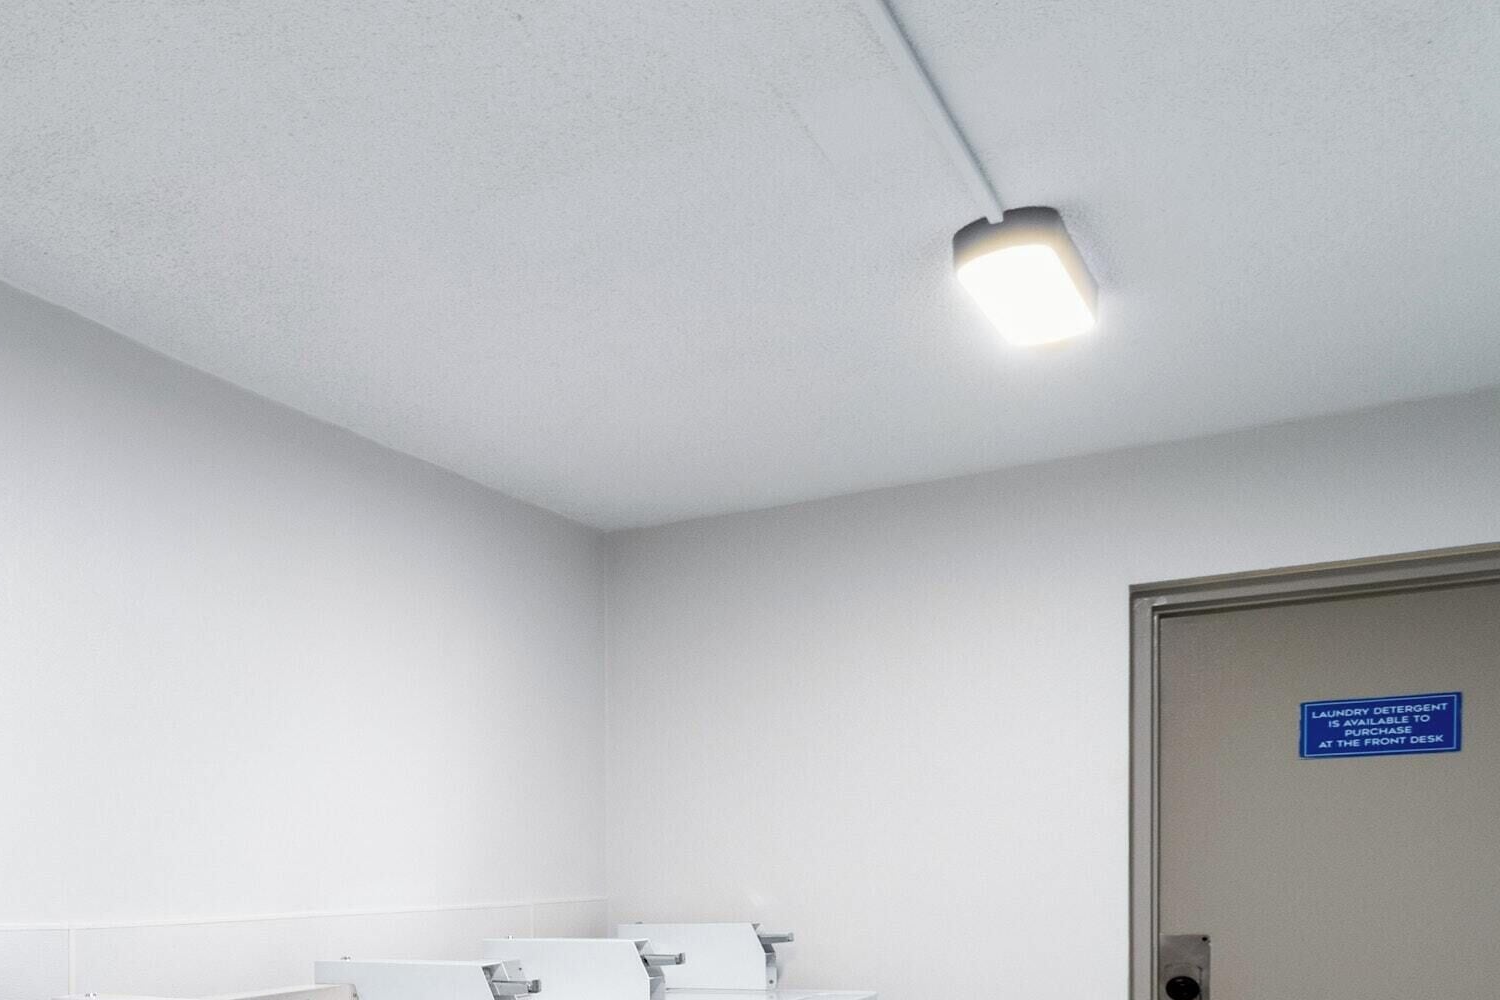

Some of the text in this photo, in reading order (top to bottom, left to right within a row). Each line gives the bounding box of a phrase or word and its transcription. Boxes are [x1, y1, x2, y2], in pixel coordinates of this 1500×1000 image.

[1312, 703, 1449, 719] LAUNDRY DETERGENT
[1328, 714, 1430, 728] IS AVAILABLE TO
[1345, 726, 1412, 737] PURCHASE
[1318, 735, 1444, 748] AT THE FRONT DESK
